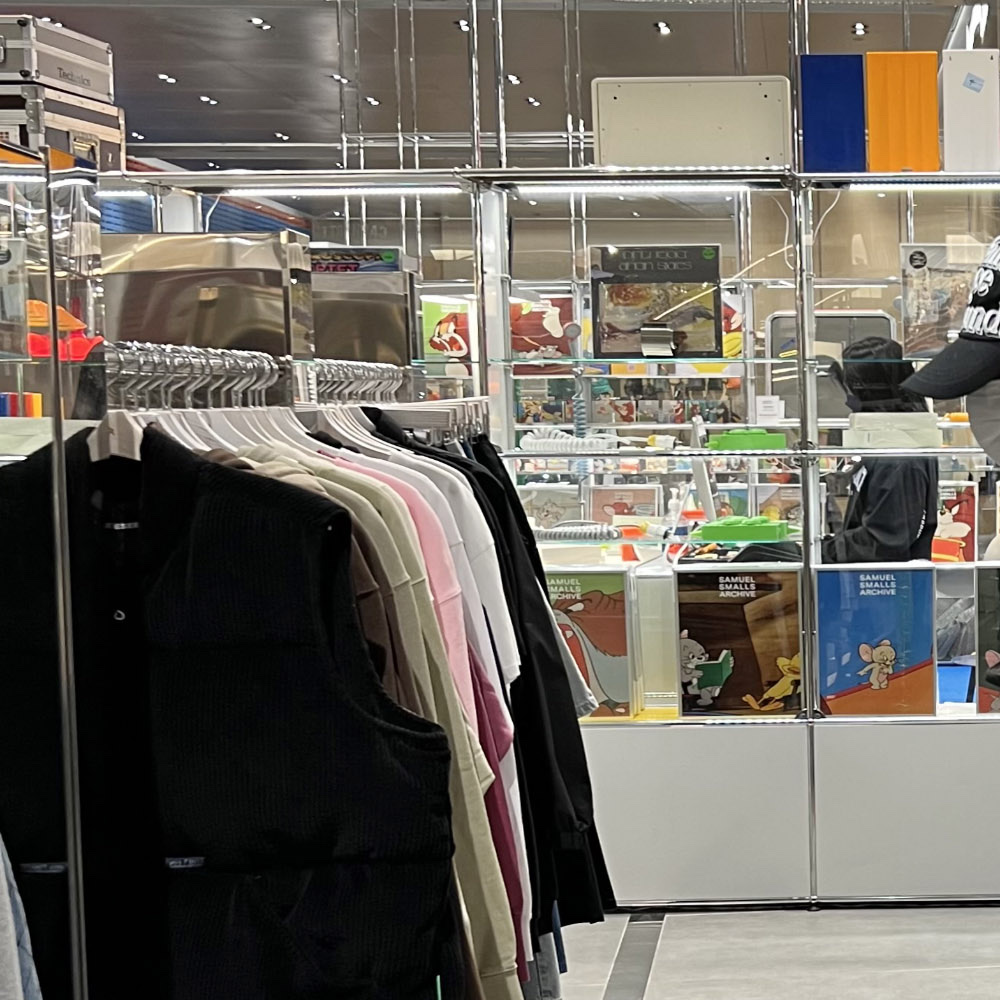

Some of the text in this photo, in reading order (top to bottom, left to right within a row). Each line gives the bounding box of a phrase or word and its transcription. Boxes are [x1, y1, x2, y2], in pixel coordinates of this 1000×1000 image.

[860, 573, 897, 581] SAMUEL
[547, 578, 581, 586] AMUEL
[549, 585, 582, 593] MALLS
[719, 583, 756, 591] SMALLS
[719, 590, 757, 598] ARCHIVE
[860, 588, 897, 596] ARCHIVE
